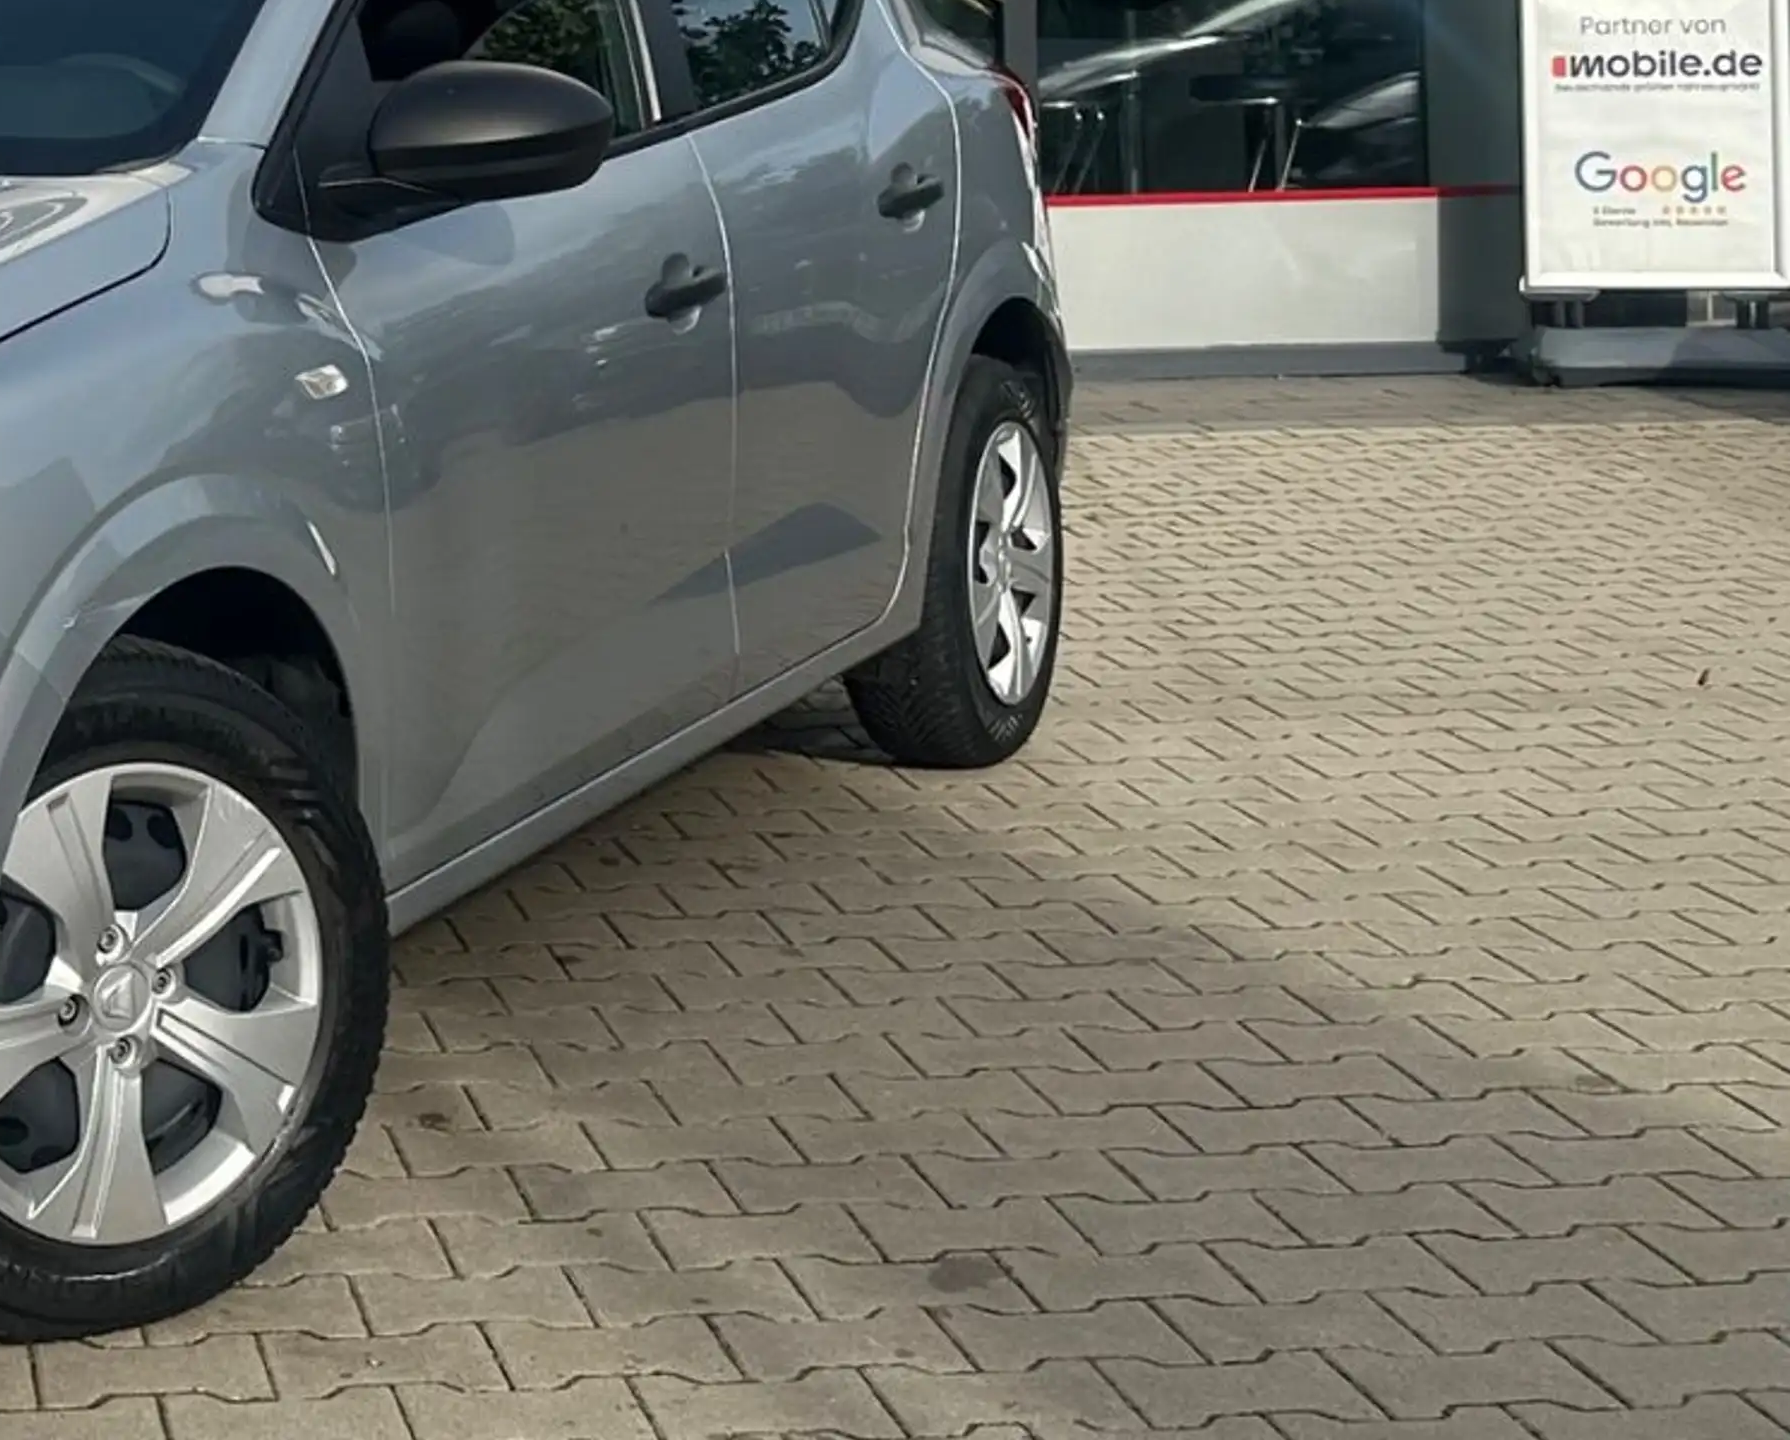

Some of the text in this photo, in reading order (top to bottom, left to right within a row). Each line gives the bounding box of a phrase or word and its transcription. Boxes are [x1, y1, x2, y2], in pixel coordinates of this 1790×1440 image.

[1579, 16, 1726, 36] Partner von
[1569, 49, 1763, 78] mobile.de
[1574, 150, 1747, 204] Google
